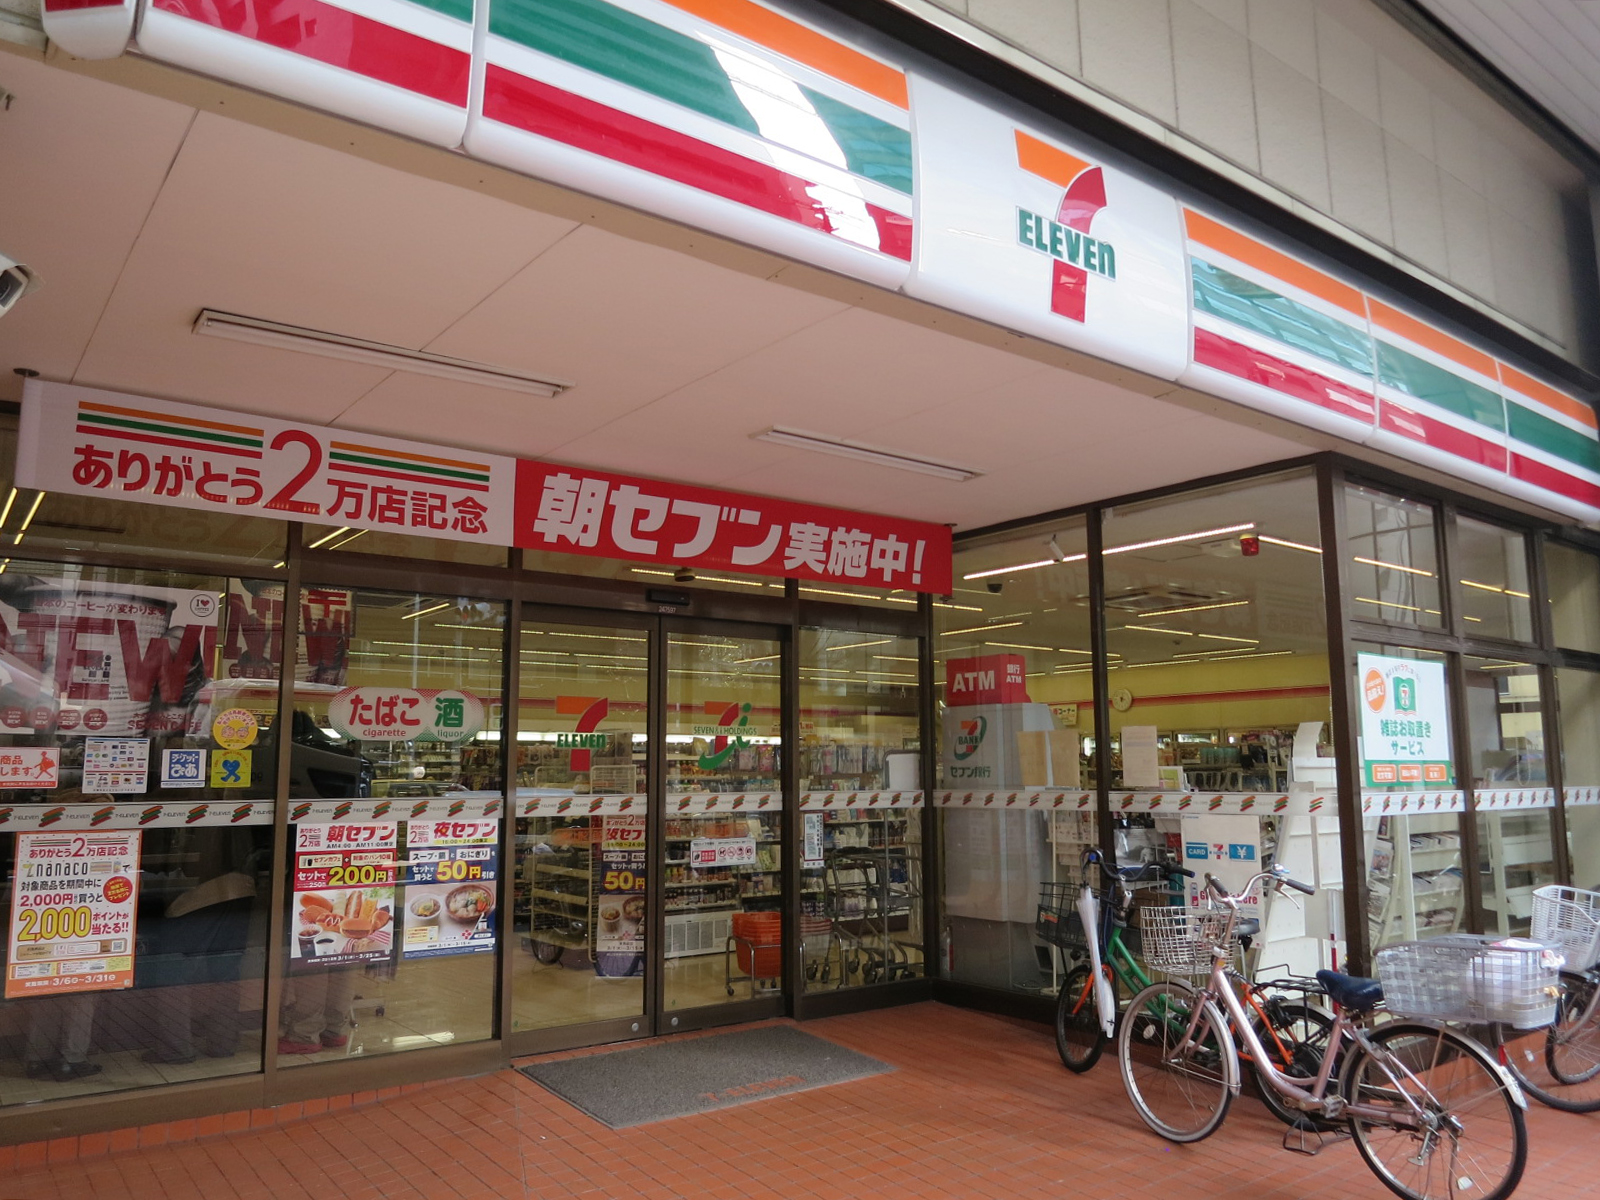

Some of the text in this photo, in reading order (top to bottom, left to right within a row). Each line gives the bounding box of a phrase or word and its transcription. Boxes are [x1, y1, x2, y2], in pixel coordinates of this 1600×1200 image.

[1014, 129, 1107, 323] 7
[72, 429, 490, 535] ありがとう2万店記念
[533, 472, 926, 584] 朝セブン実施中!
[1006, 663, 1020, 674] 銀行
[952, 670, 995, 693] ATM
[1006, 675, 1022, 684] ATM
[348, 694, 465, 728] たばこ 酒
[362, 727, 465, 739] cigarette liquor
[958, 736, 980, 746] BANK
[1390, 741, 1424, 756] サービス
[950, 765, 991, 778] セブン銀行
[326, 825, 395, 843] 朝セブン
[409, 830, 418, 844] 2
[433, 821, 497, 839] 夜セブン
[29, 837, 129, 859] ありがとう2万店記念
[299, 834, 308, 848] 2
[459, 850, 488, 859] おにぎり
[1188, 848, 1206, 856] CARD
[36, 862, 88, 877] nanaco
[328, 864, 387, 887] 200円
[20, 878, 102, 892] 対象商品を期間中に
[20, 893, 73, 907] 2,000円
[78, 893, 103, 904] 買うと
[92, 912, 129, 921] ポイントが
[17, 905, 93, 943] 2,000
